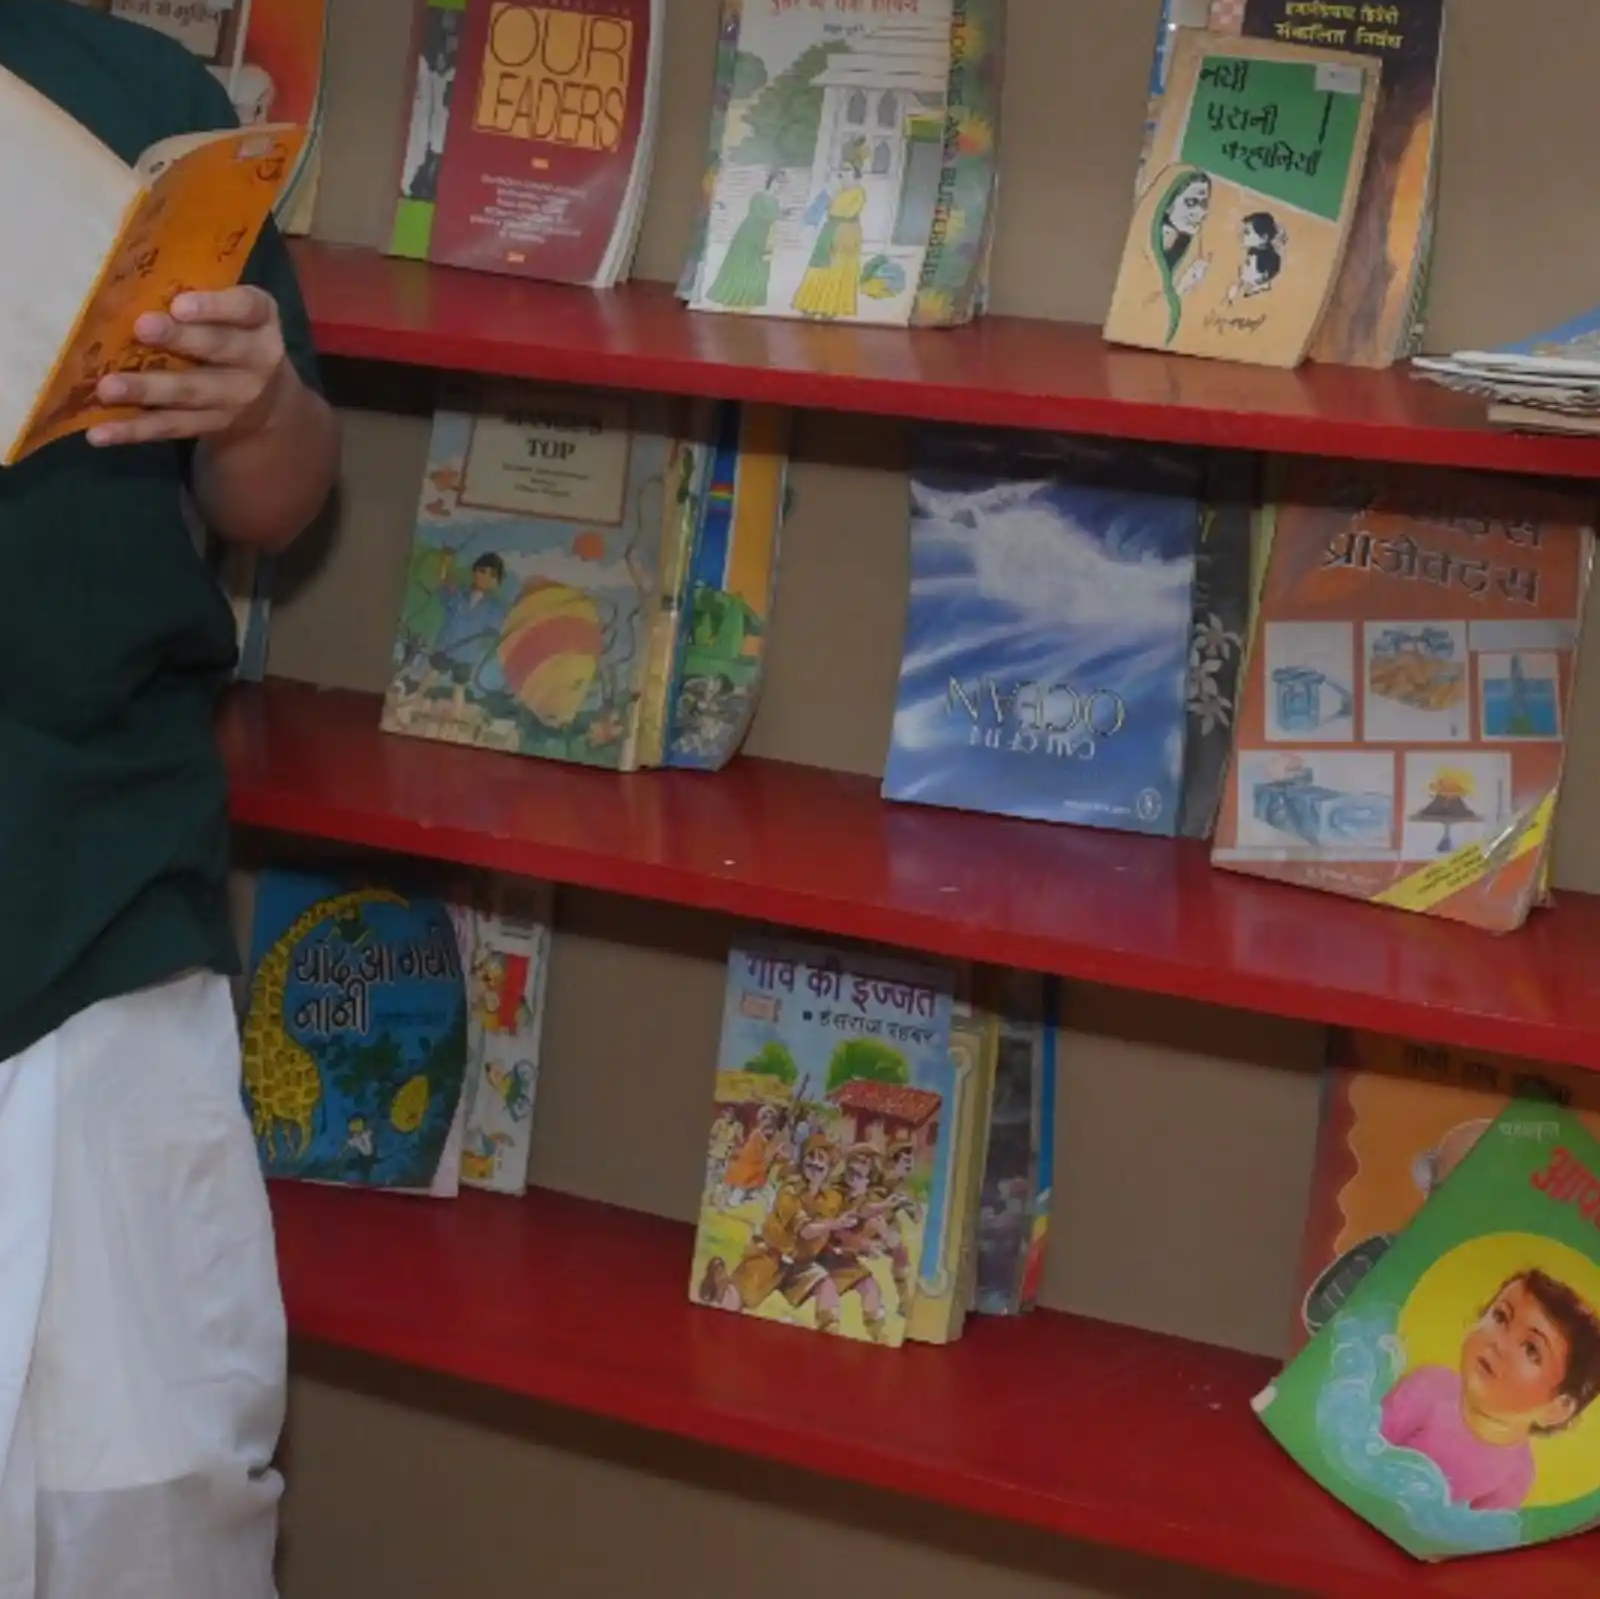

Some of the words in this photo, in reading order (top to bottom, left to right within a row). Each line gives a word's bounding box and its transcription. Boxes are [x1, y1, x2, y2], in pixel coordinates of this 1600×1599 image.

[488, 3, 629, 83] OUR
[1199, 58, 1250, 92] नयी
[476, 72, 626, 151] LEADERS
[1206, 100, 1279, 137] पुरानी
[527, 437, 577, 461] TOP
[943, 676, 1128, 739] OCEAN
[357, 942, 396, 984] आ
[806, 956, 843, 1002] की
[851, 972, 939, 1018] इज्जत
[293, 982, 371, 1037] नानी
